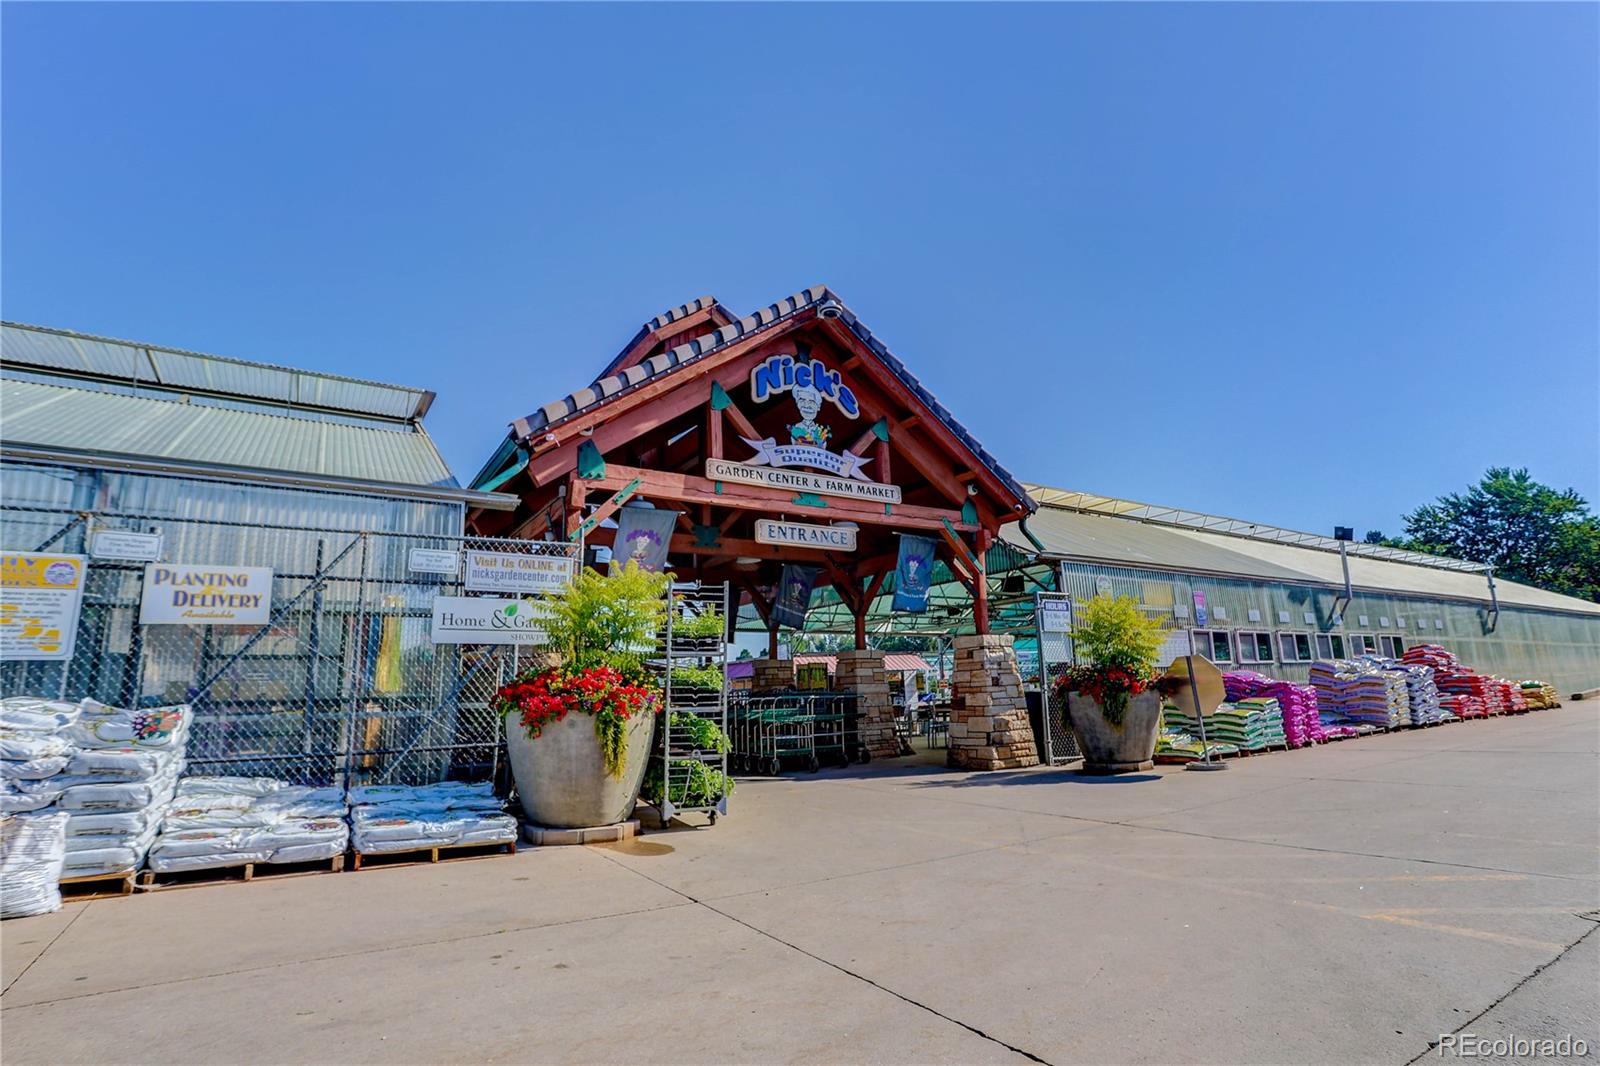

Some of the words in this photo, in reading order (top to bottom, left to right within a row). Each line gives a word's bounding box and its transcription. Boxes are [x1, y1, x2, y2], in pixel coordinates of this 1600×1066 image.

[753, 355, 859, 417] Nick's
[774, 448, 847, 465] Superior
[782, 456, 840, 473] Quality
[716, 464, 764, 480] GARDEN
[768, 472, 809, 488] CENTER
[813, 478, 821, 488] &
[826, 480, 853, 493] FARM
[857, 484, 895, 499] MARKET
[767, 524, 848, 545] ENTRANCE
[474, 556, 497, 567] Visit
[501, 558, 515, 569] Us
[518, 559, 555, 571] ONLINE
[557, 562, 568, 572] at
[154, 568, 249, 588] PLANTING
[472, 568, 568, 584] nicksgardencenter.com
[172, 590, 263, 608] DELIVERY
[181, 609, 236, 619] Available
[441, 612, 486, 627] Home
[491, 609, 512, 629] &
